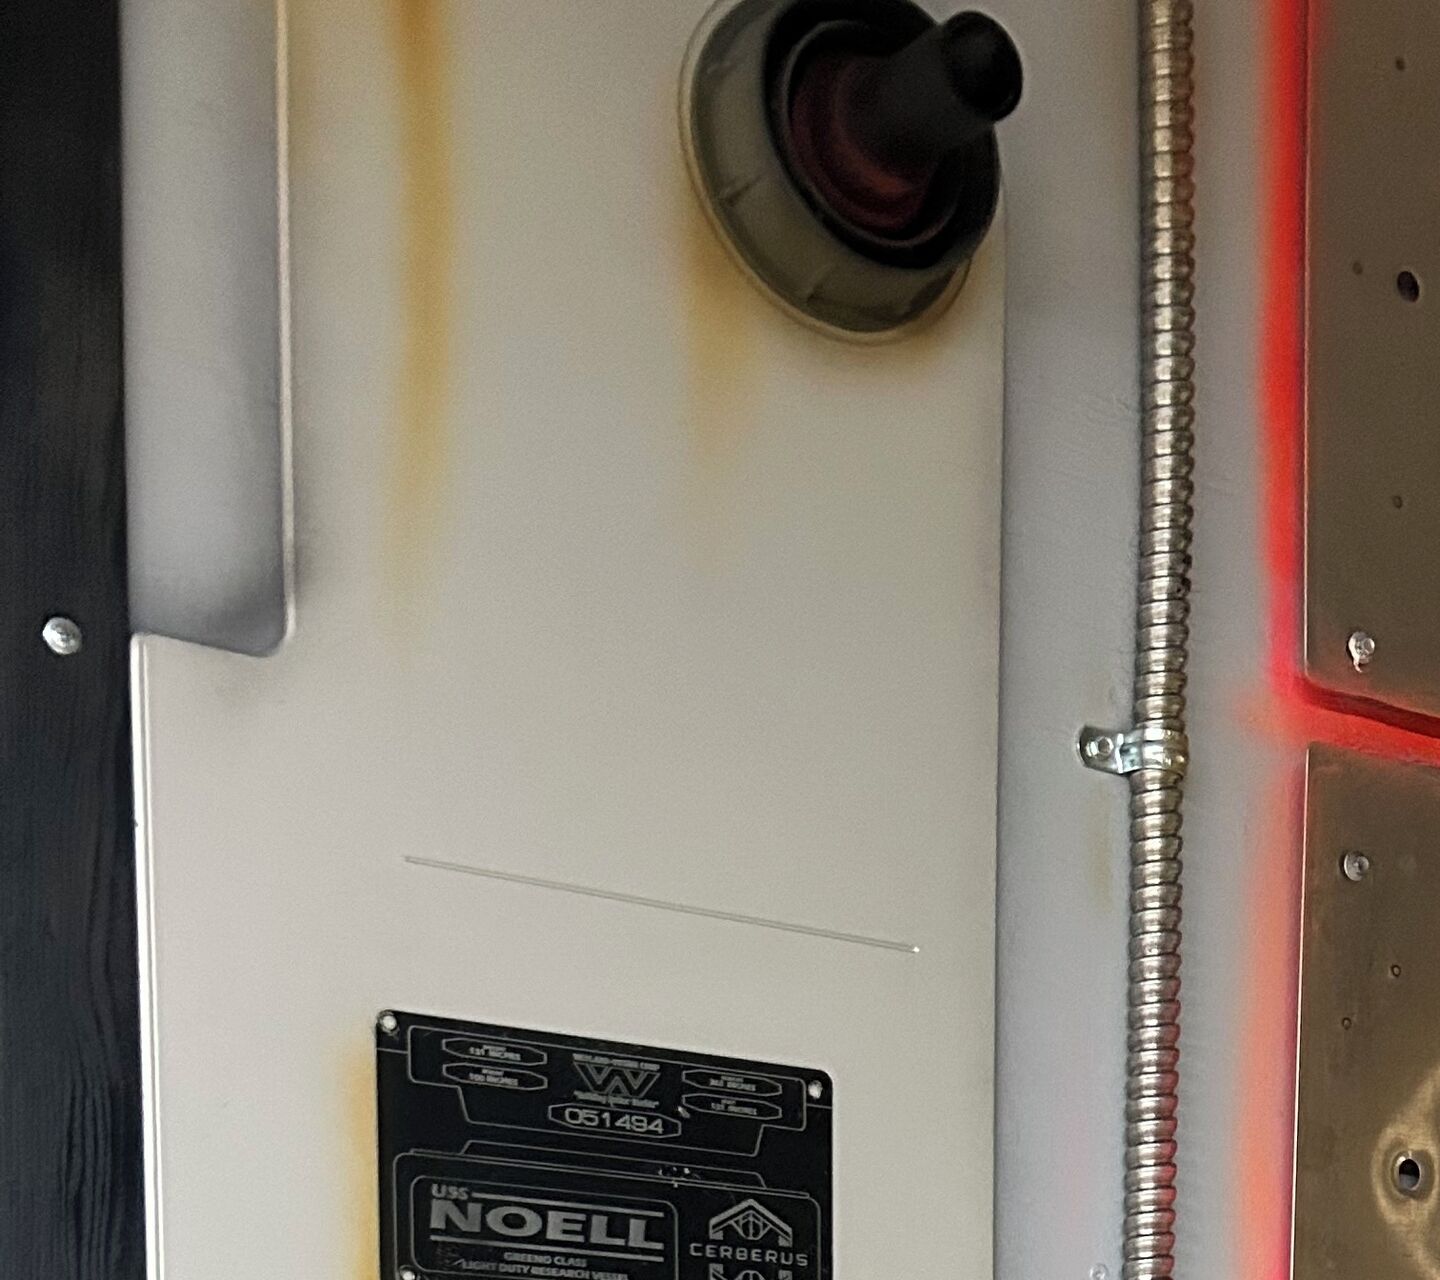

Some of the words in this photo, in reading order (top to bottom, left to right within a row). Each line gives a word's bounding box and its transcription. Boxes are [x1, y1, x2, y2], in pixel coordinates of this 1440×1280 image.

[431, 1183, 469, 1200] USS
[430, 1198, 665, 1250] NOELL
[689, 1243, 809, 1267] CERBERUS
[462, 1259, 498, 1272] LIGHT
[499, 1262, 531, 1275] DUTY
[530, 1265, 590, 1280] RESEARCH
